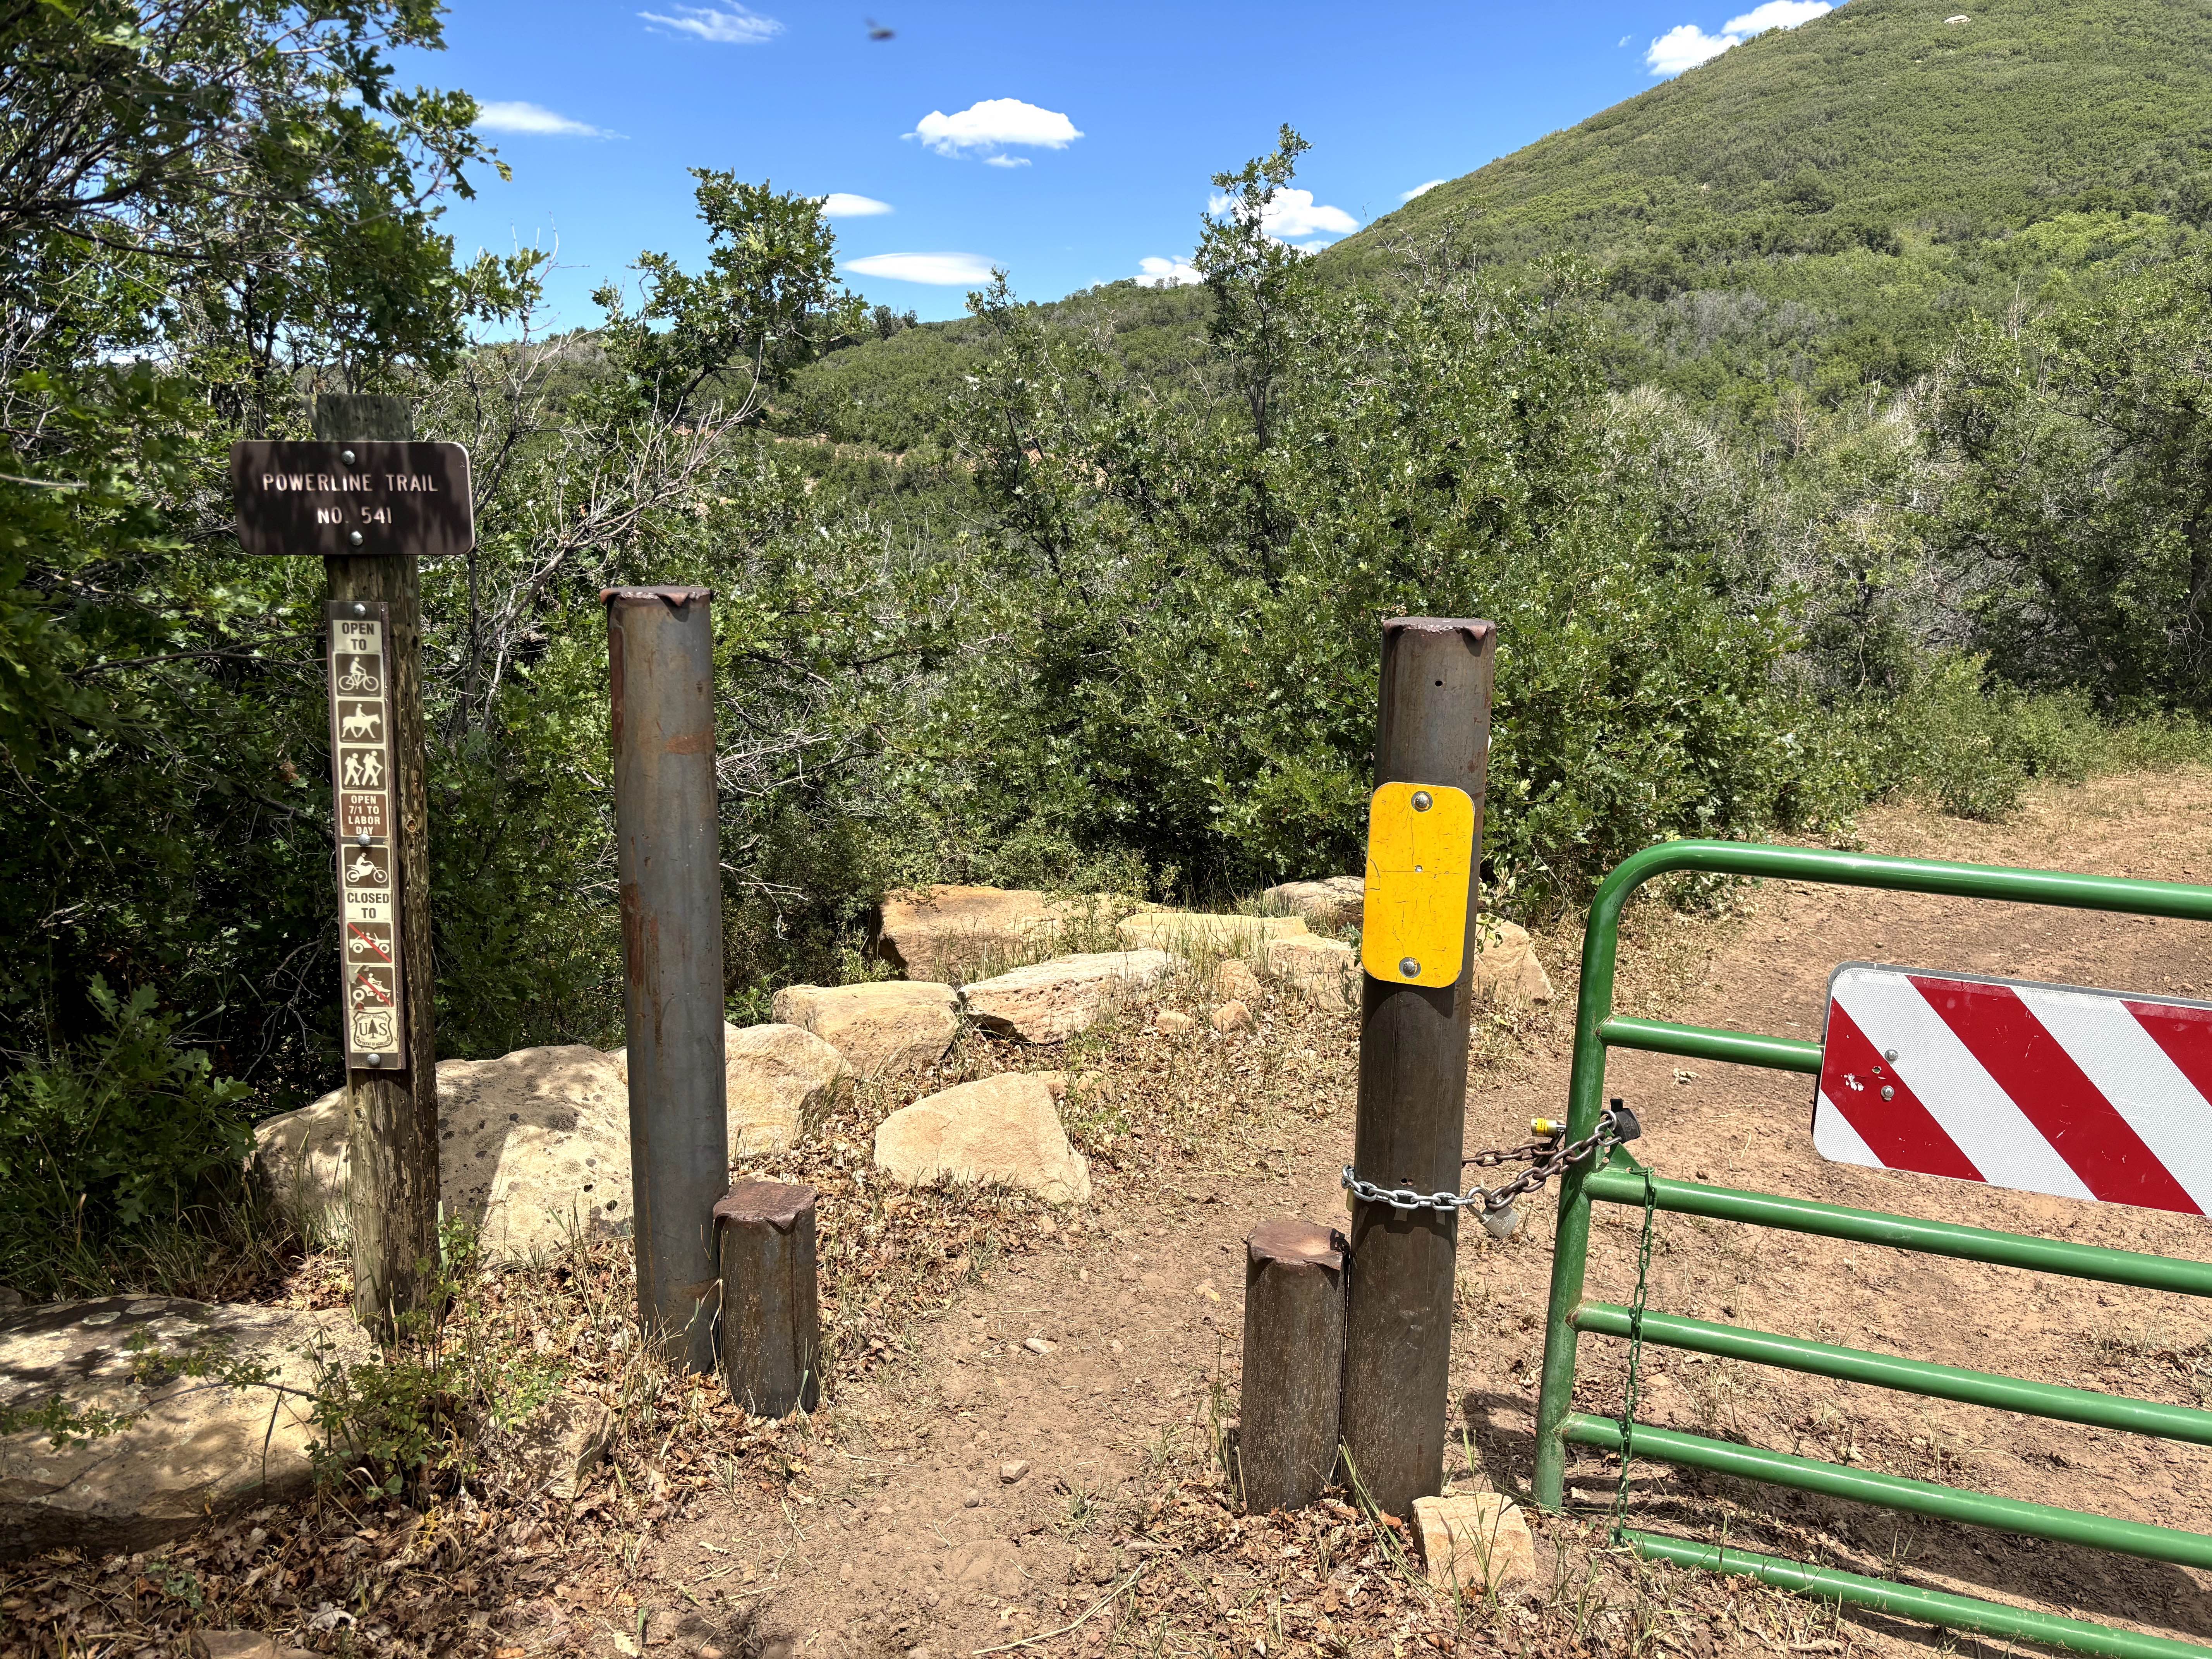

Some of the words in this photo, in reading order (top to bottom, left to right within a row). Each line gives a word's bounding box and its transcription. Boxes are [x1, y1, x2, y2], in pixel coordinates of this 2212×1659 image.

[263, 473, 373, 491] POWERLINE
[385, 474, 438, 491] TRAIL
[361, 506, 392, 524] 541
[342, 622, 374, 635] OPEN
[350, 639, 367, 651] TO
[351, 795, 376, 804] OPEN
[349, 805, 362, 815] 7/1
[367, 806, 380, 814] TO
[348, 816, 381, 825] LABOR
[356, 826, 374, 835] DAY
[347, 892, 390, 903] CLOSED
[361, 907, 376, 919] TO
[359, 1023, 368, 1036] U
[379, 1023, 388, 1036] S
